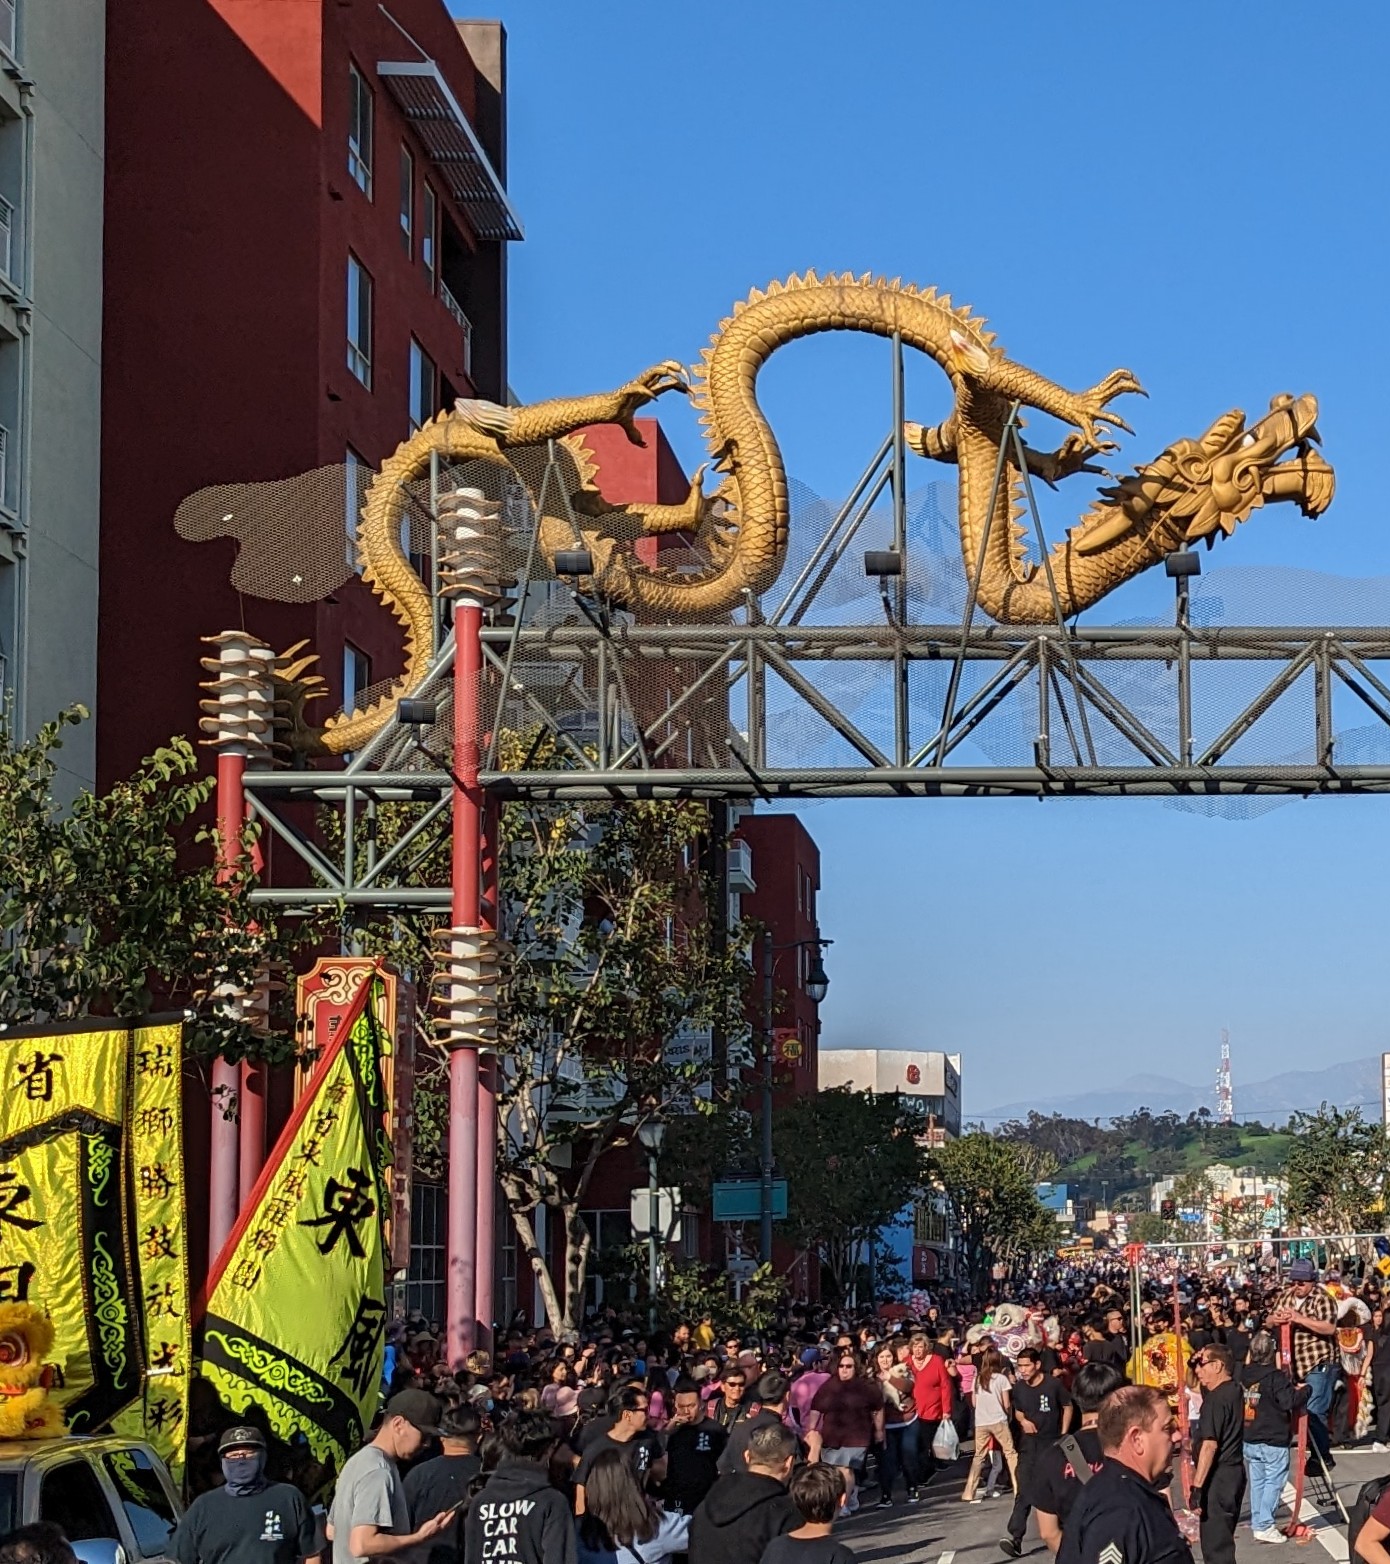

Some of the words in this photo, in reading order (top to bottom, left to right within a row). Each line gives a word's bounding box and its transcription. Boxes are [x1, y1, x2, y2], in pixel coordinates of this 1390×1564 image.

[783, 1042, 802, 1058] 福
[9, 1049, 65, 1102] 省
[479, 1499, 536, 1520] SLOW
[483, 1517, 518, 1537] CAR
[482, 1537, 518, 1558] CAR
